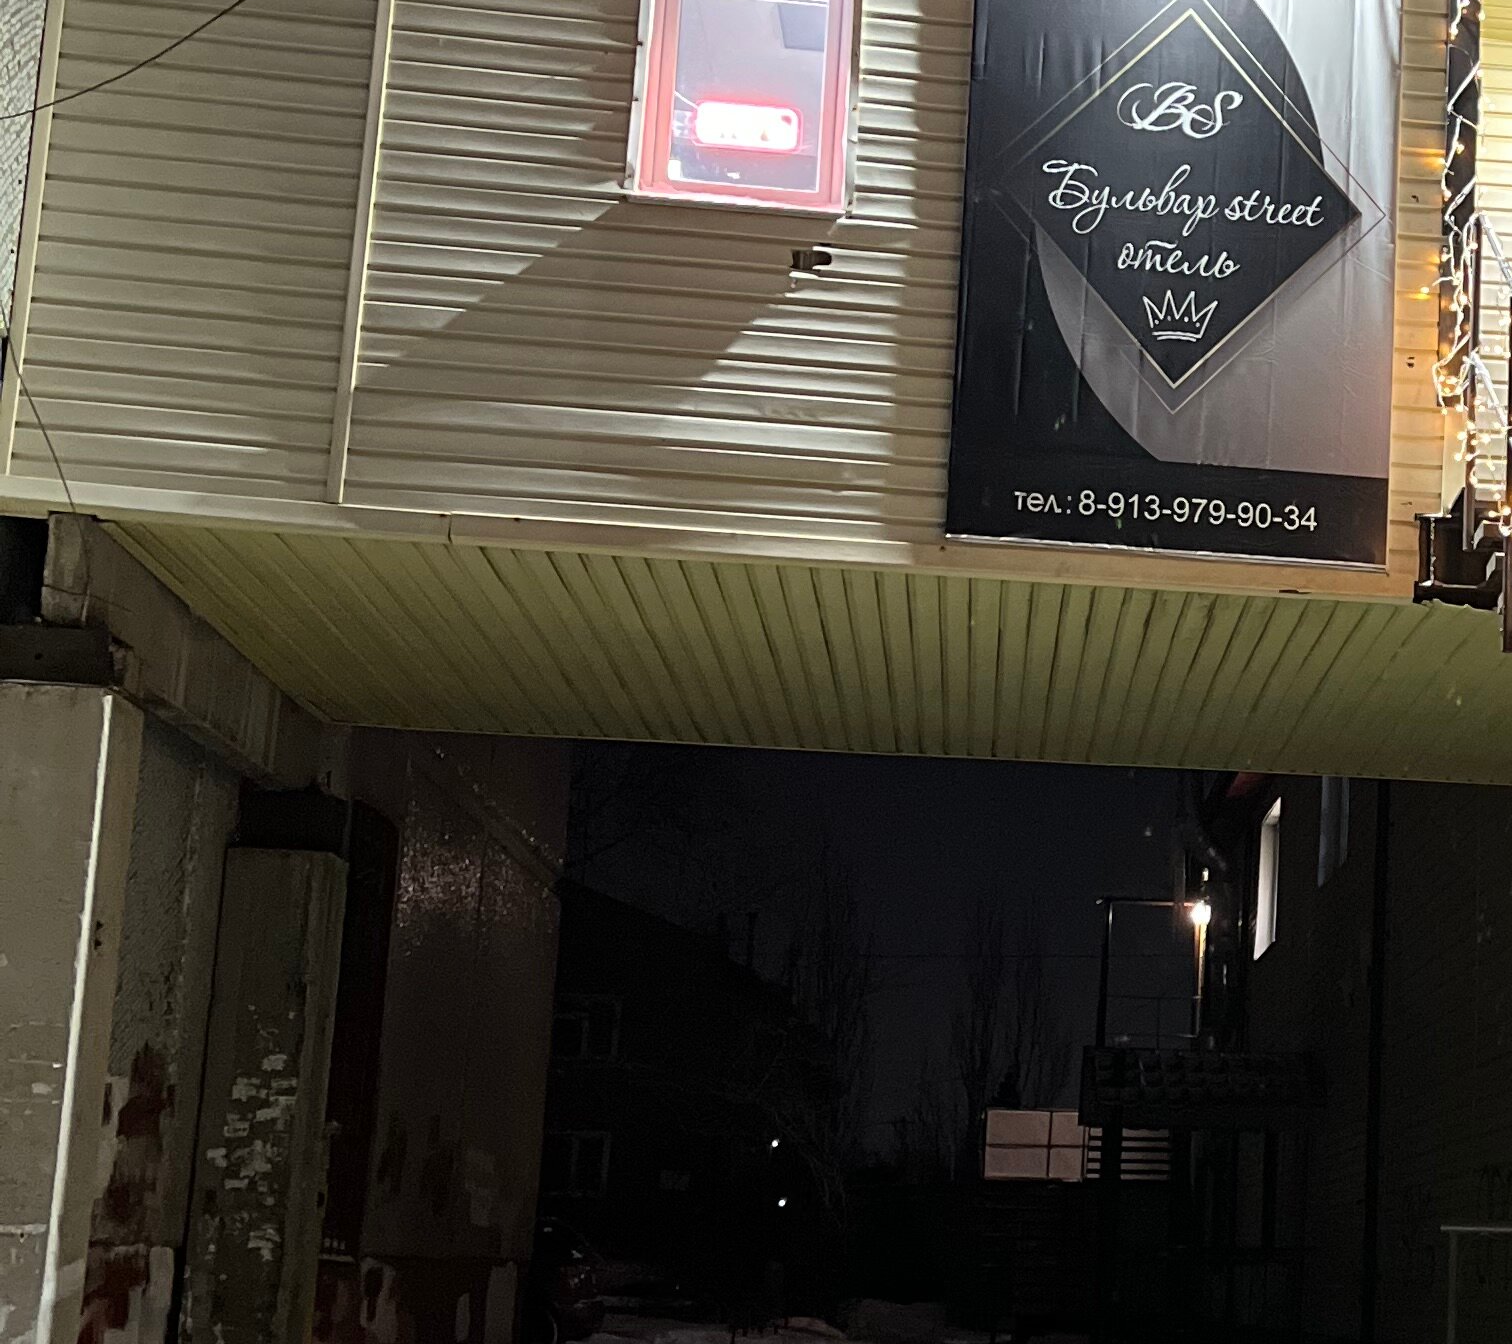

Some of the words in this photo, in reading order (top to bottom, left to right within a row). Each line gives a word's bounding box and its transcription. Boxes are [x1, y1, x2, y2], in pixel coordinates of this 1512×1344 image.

[1042, 159, 1220, 237] Бульвар
[1224, 189, 1325, 227] street
[1117, 239, 1241, 278] отель
[1078, 489, 1318, 532] 8-913-979-90-34
